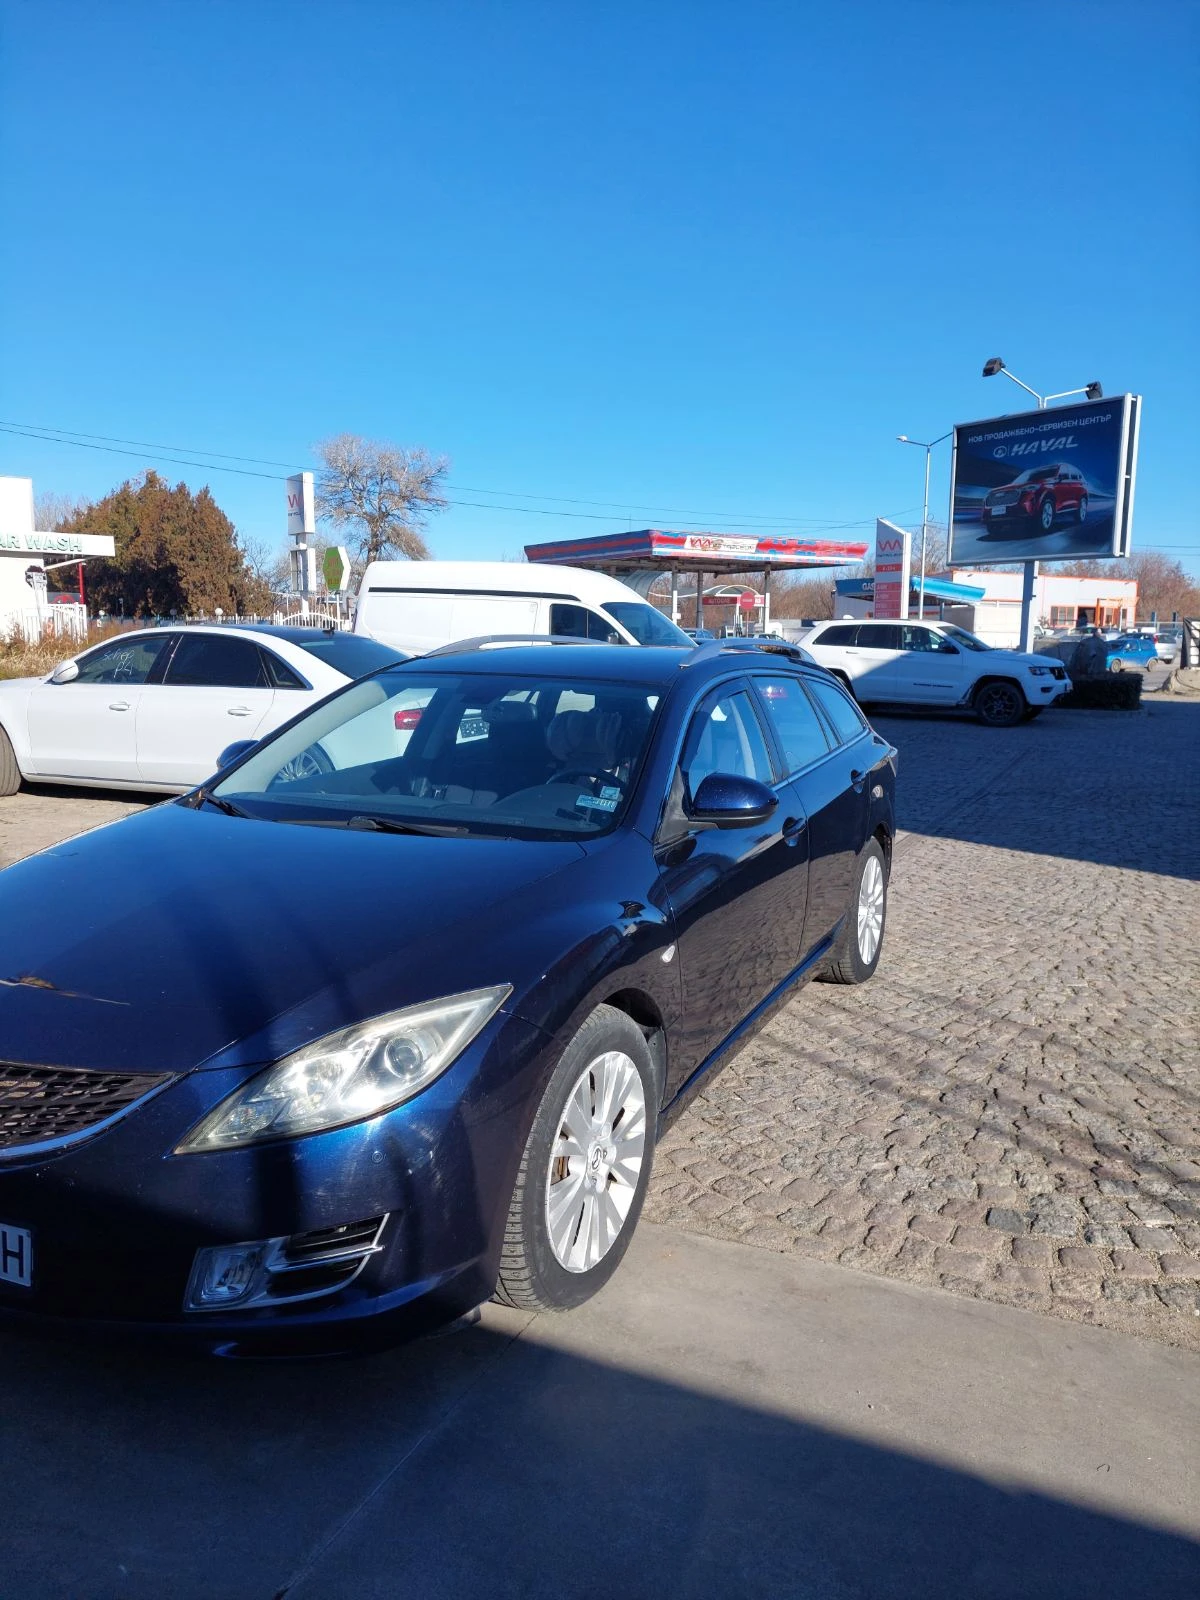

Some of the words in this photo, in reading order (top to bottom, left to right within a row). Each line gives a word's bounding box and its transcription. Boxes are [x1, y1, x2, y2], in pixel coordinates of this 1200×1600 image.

[968, 435, 983, 443] НОВ
[1079, 414, 1112, 426] ЦЕНТЪР
[1010, 435, 1079, 456] HAVAL
[24, 533, 82, 552] WASH
